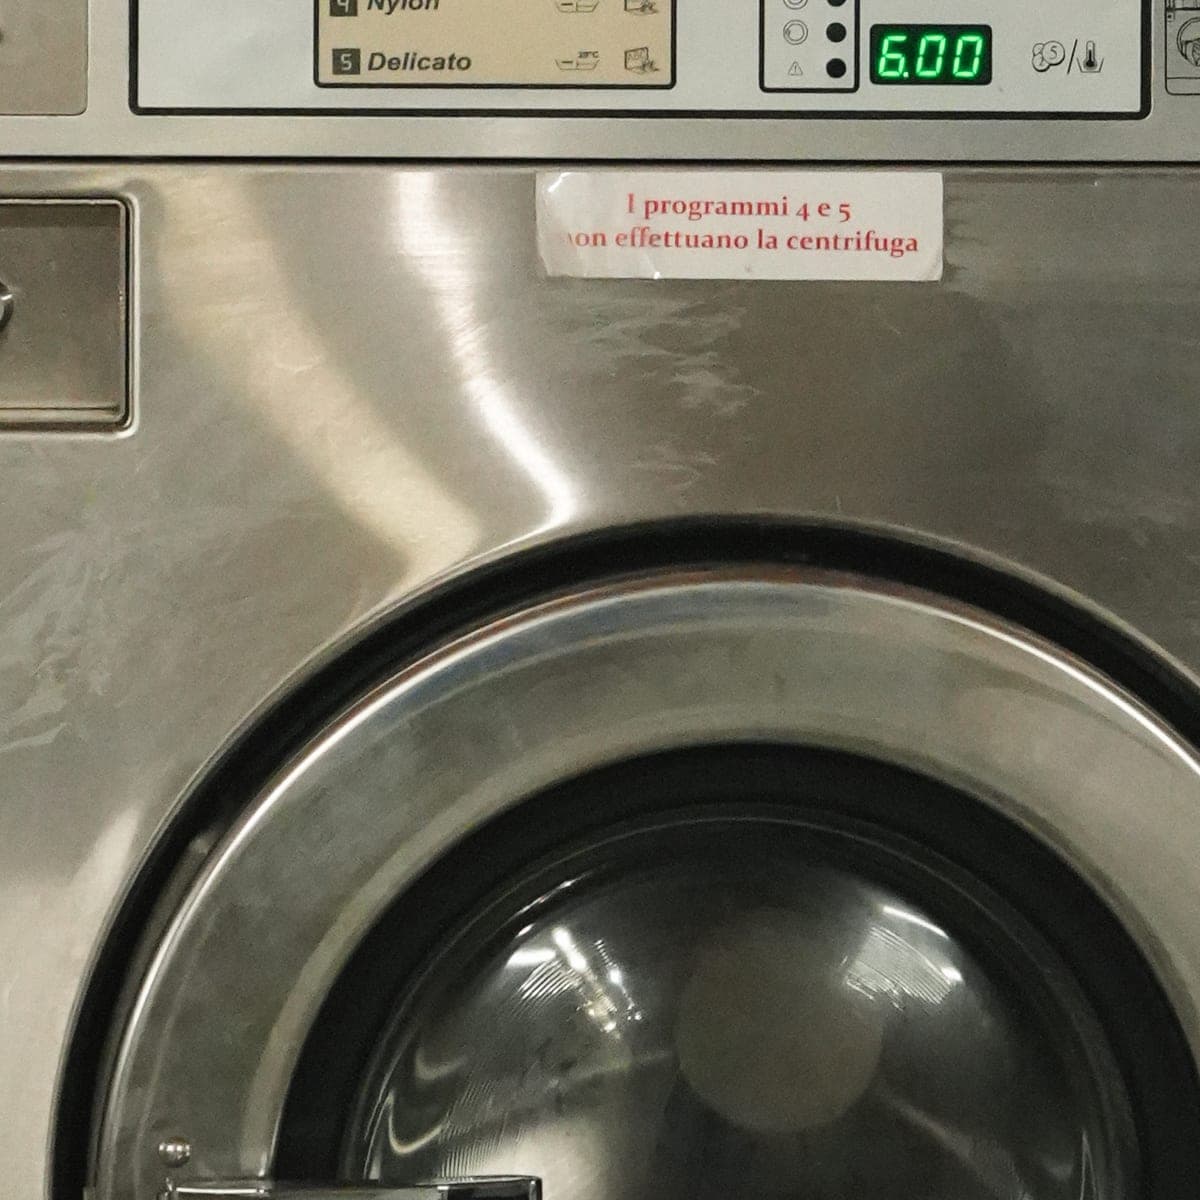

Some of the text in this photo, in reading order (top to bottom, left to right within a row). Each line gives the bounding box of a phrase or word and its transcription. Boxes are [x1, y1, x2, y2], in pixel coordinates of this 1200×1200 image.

[367, 0, 440, 15] Nylon
[367, 52, 472, 71] Delicato
[878, 34, 983, 78] 6.00
[644, 196, 789, 220] programmi
[796, 202, 810, 222] 4
[817, 202, 832, 217] e
[838, 202, 852, 222] 5
[615, 225, 749, 250] effettuano
[757, 229, 778, 250] la
[786, 230, 919, 258] centrifuga
